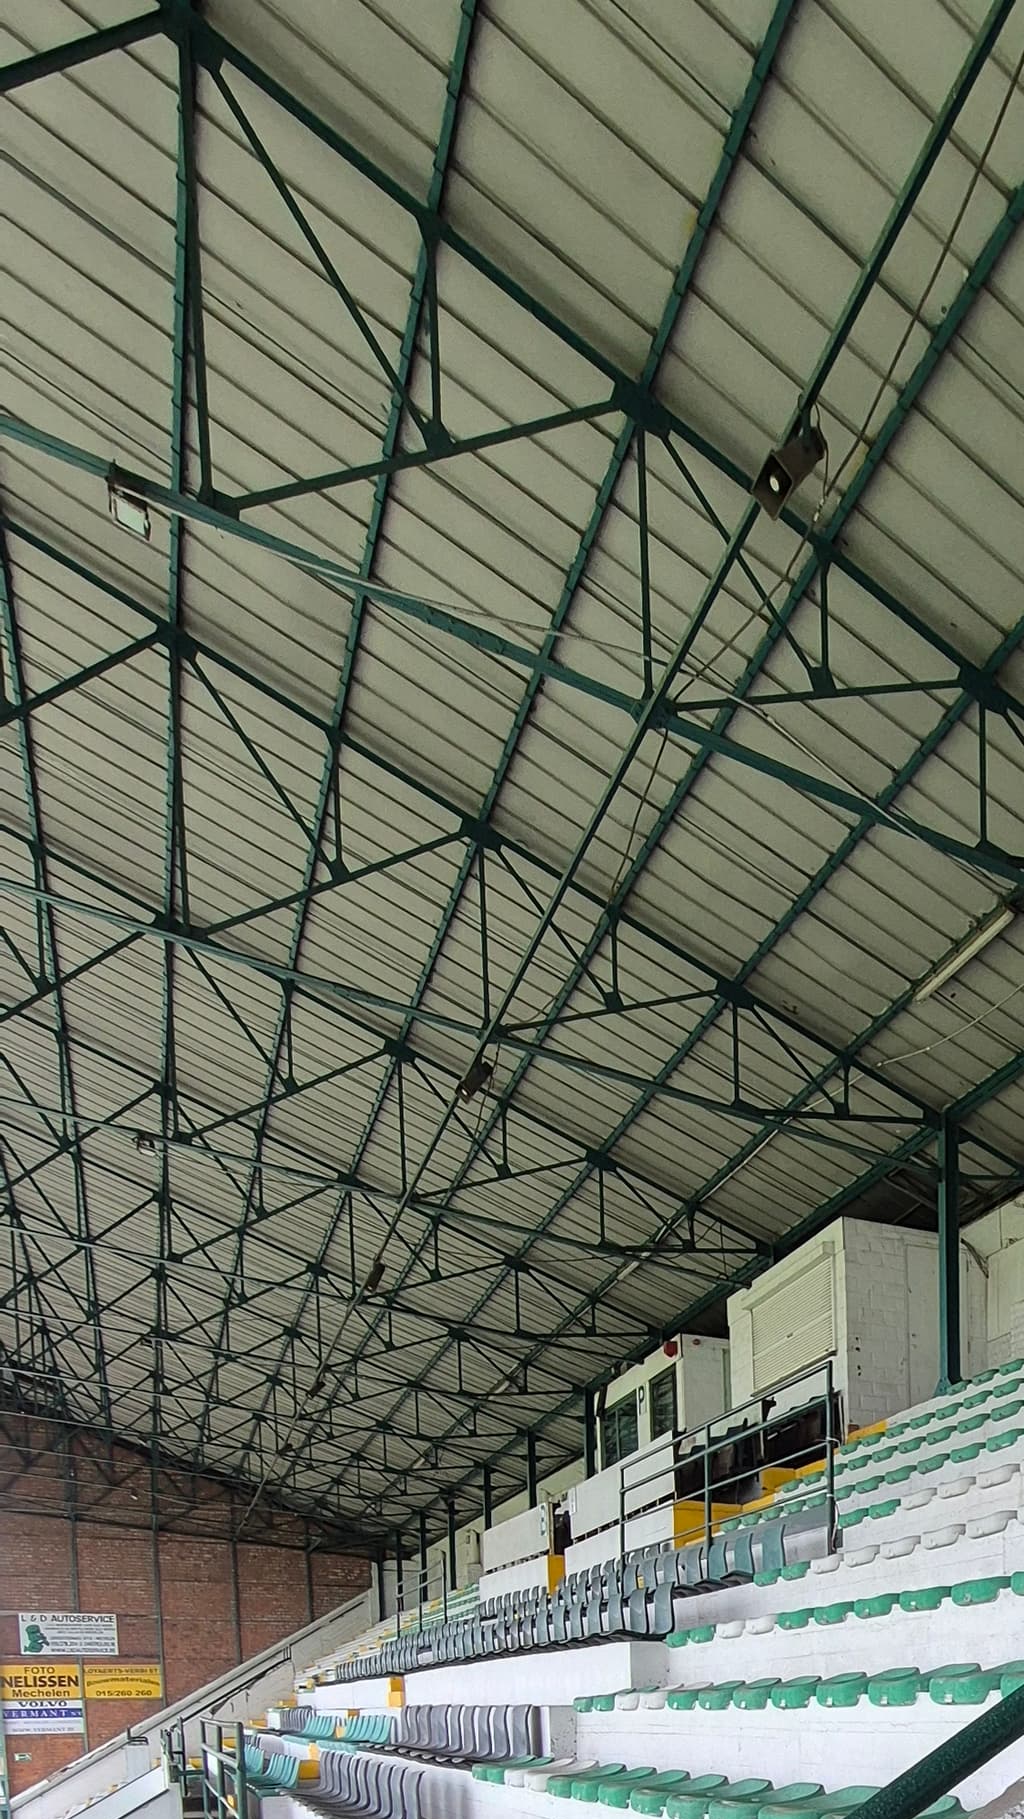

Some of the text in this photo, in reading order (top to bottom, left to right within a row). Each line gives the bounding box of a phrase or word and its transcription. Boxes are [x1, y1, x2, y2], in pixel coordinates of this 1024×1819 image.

[51, 1615, 115, 1623] AUTOSERVICE
[24, 1666, 55, 1674] FOTO
[1, 1675, 79, 1687] NELISSEN
[12, 1689, 71, 1697] Mechelen
[3, 1709, 67, 1717] VERMANT
